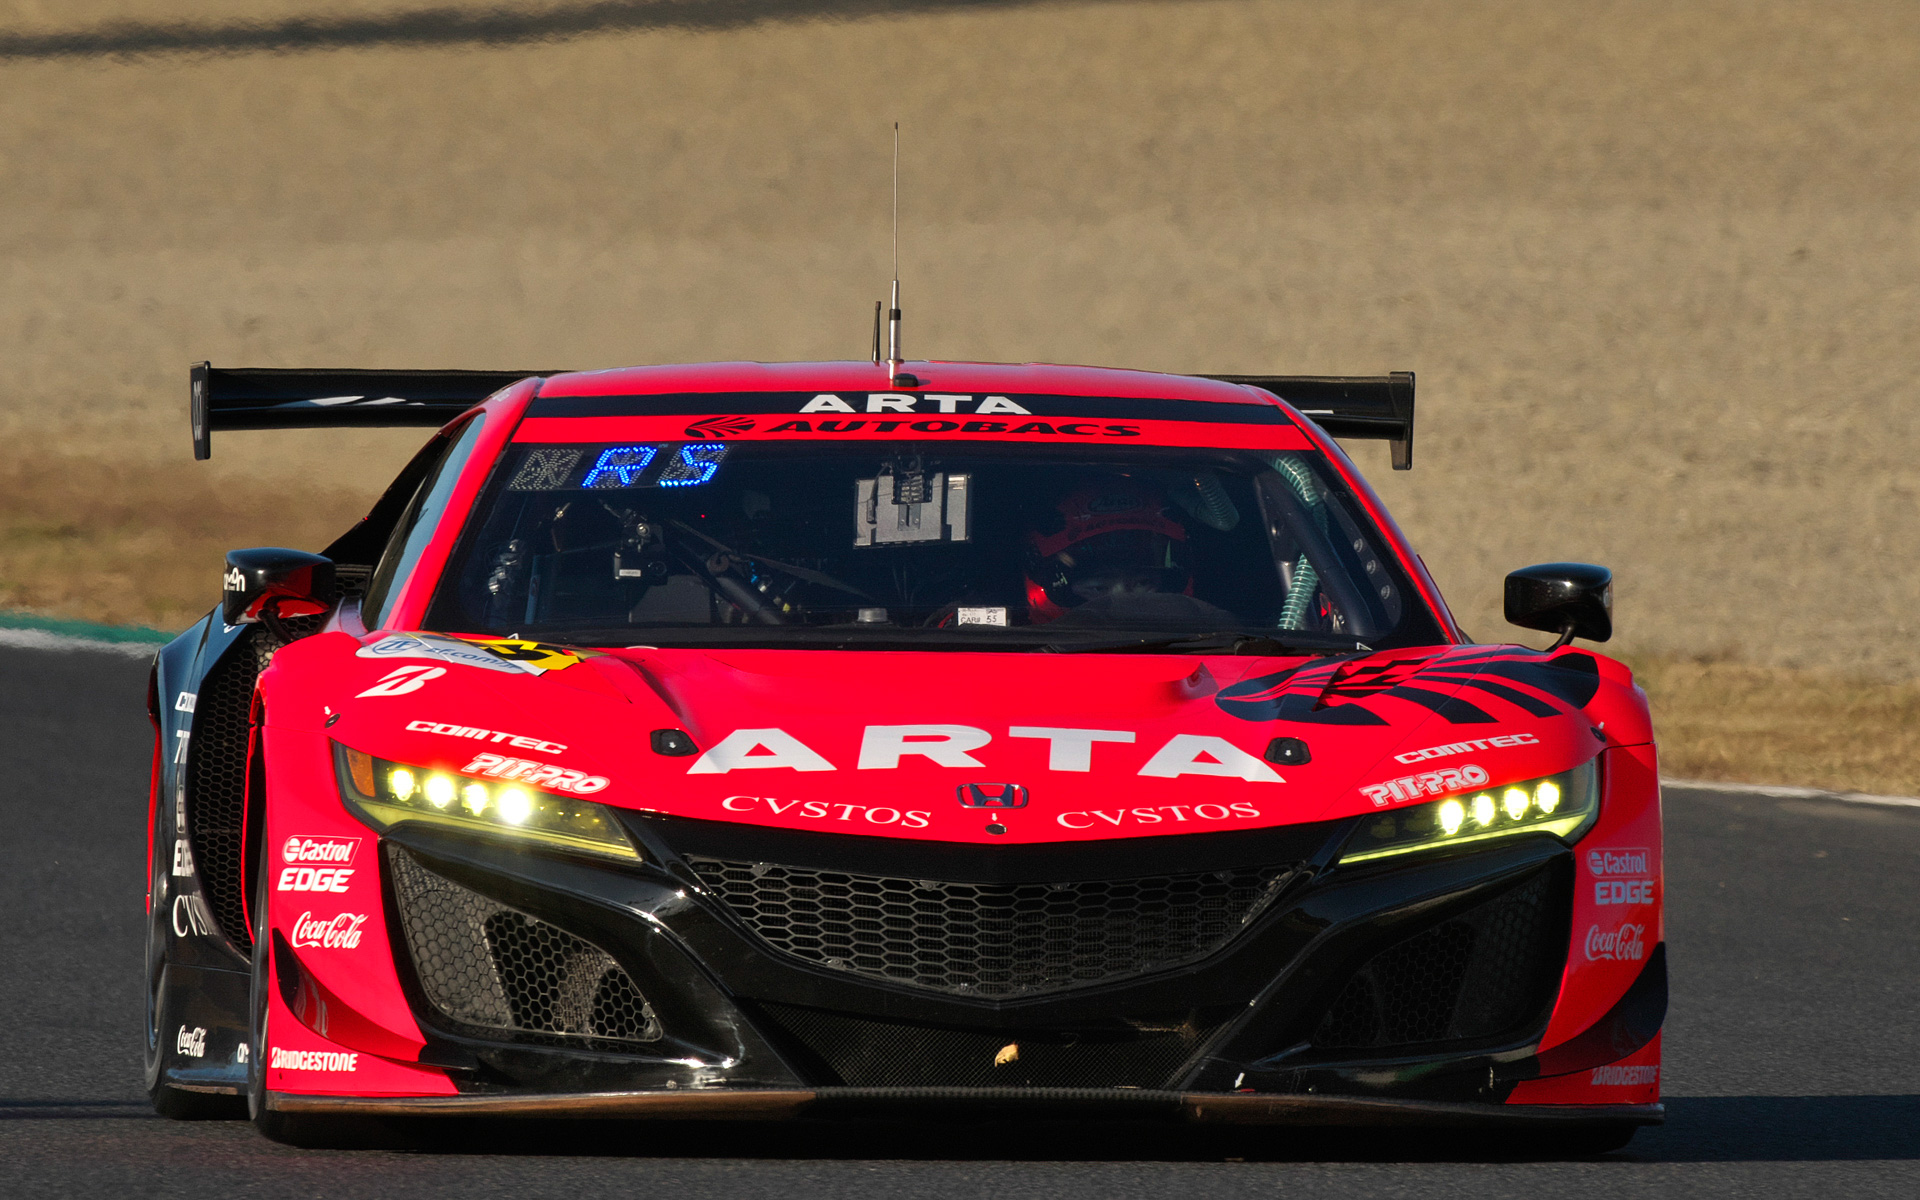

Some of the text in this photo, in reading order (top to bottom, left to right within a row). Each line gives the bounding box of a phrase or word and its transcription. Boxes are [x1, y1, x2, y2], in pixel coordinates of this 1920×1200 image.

[799, 394, 1032, 416] ARTA
[765, 420, 1141, 437] AUTOBACS
[405, 720, 568, 754] COMTEC
[1394, 733, 1540, 764] COMTEC
[686, 724, 1288, 783] ARTA
[721, 795, 932, 829] CVSTOS
[1056, 802, 1262, 830] CVSTOS
[299, 838, 355, 862] Castrol
[1604, 851, 1648, 873] Castrol
[277, 867, 355, 893] EDGE
[1595, 880, 1655, 905] EDGE
[292, 911, 369, 949] Coca-Cola
[1585, 924, 1645, 961] Coca-Cola
[271, 1047, 358, 1072] BRIDGESTONE
[1591, 1065, 1659, 1086] BRIDGESTONE
